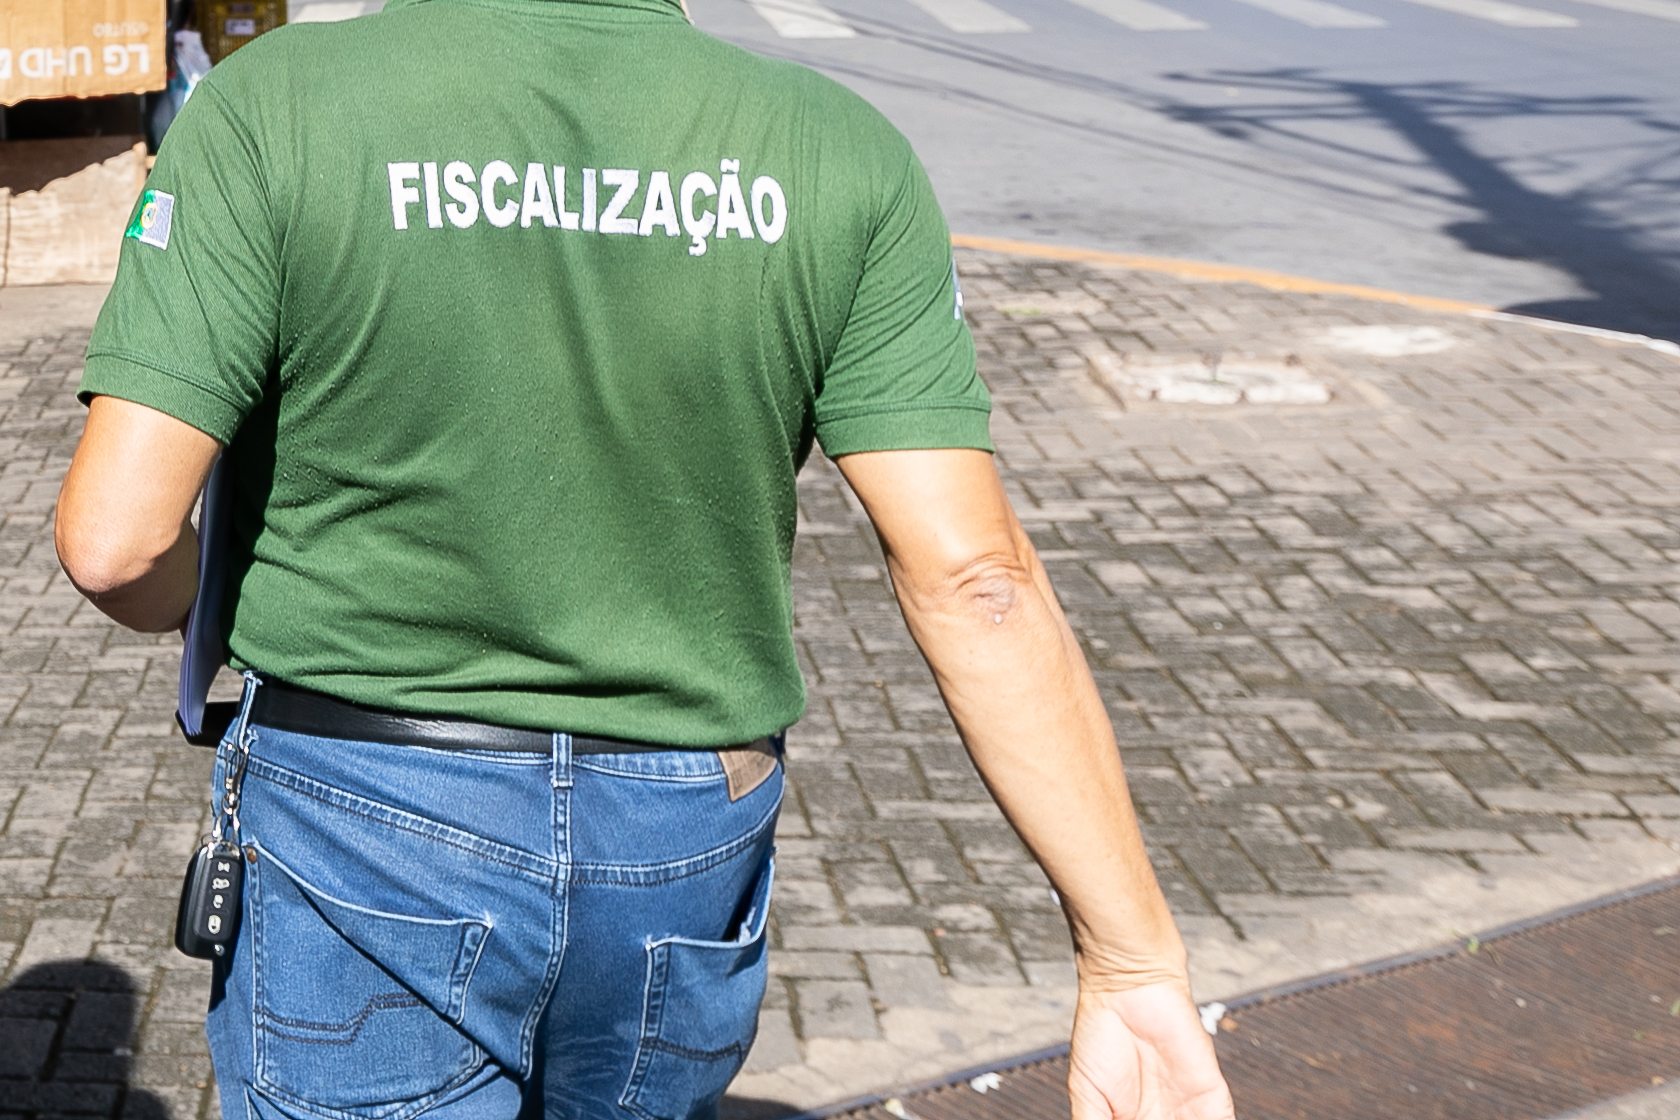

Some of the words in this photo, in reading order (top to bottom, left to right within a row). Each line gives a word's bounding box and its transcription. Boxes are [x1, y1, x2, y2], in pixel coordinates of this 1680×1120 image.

[18, 45, 92, 78] UHD
[102, 43, 150, 76] LG
[387, 158, 788, 256] FISCALIZAÇÃO
